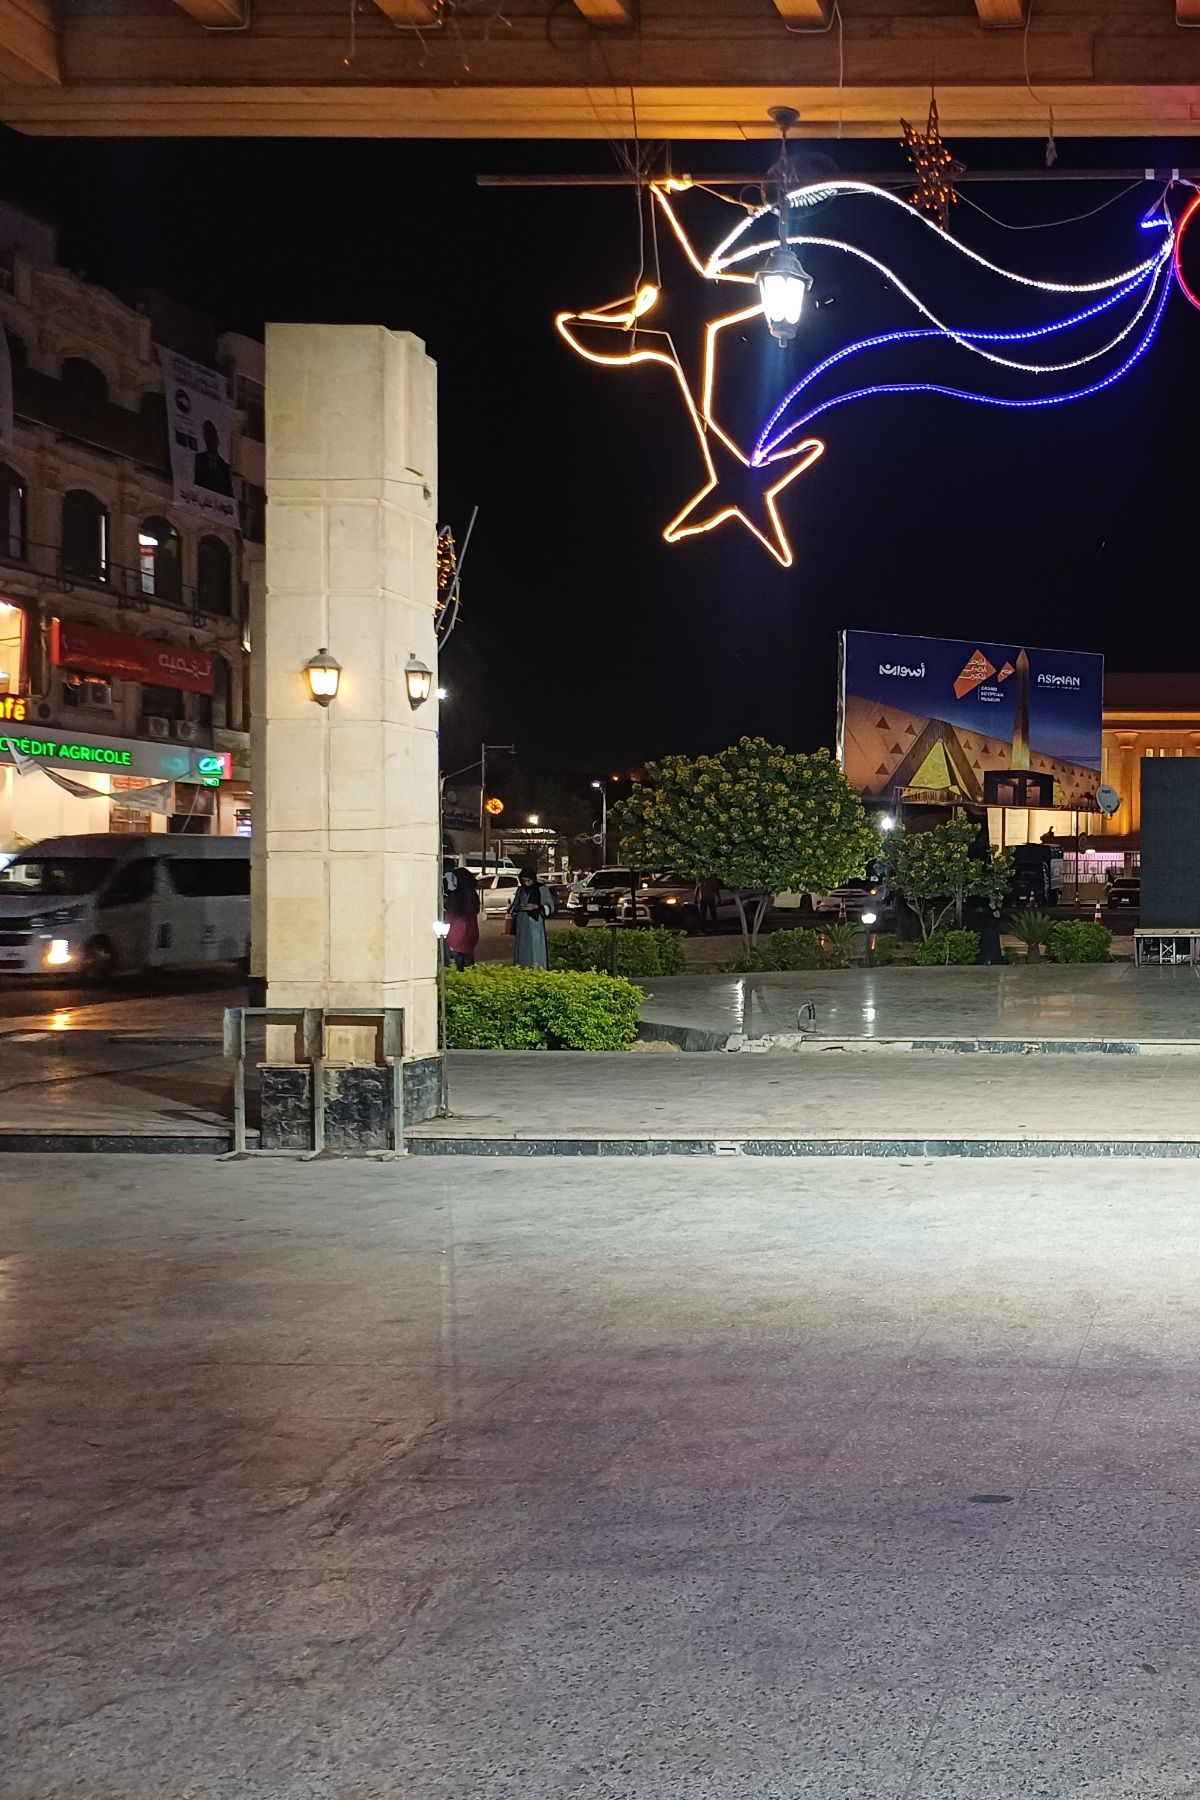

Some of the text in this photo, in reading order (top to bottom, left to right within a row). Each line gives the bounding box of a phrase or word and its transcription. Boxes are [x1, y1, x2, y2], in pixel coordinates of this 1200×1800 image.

[879, 663, 926, 679] أسوان
[1037, 673, 1080, 686] ASWAN
[58, 744, 132, 766] AGRICOLE
